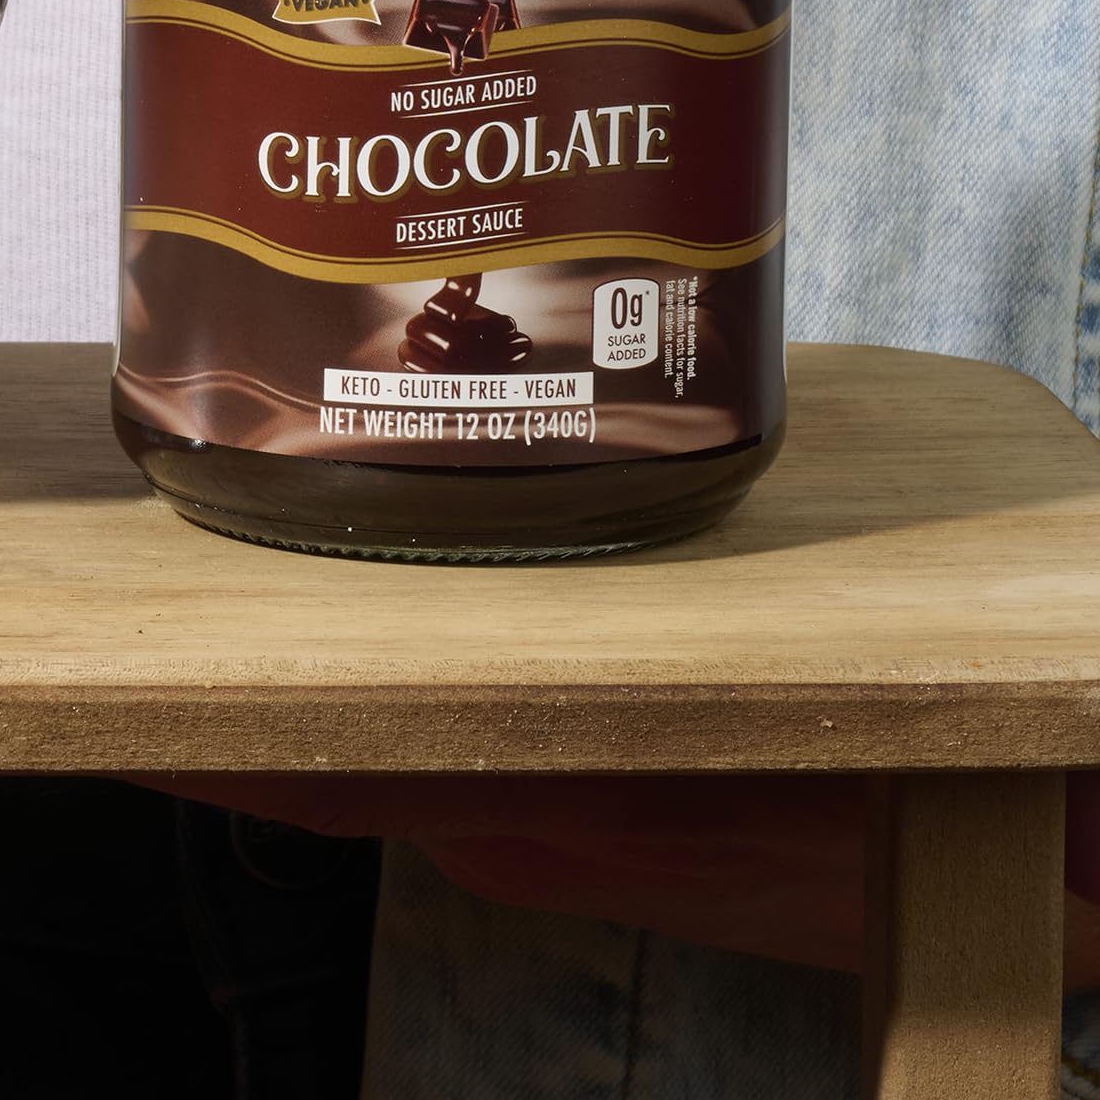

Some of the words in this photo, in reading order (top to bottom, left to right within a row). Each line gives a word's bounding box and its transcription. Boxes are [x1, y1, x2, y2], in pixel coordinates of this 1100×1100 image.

[390, 90, 414, 112] NO
[420, 83, 475, 111] SUGAR
[481, 75, 537, 103] ADDED
[258, 103, 672, 200] CHOCOLATE
[396, 216, 466, 244] DESSERT
[472, 208, 524, 233] SAUCE
[666, 280, 676, 293] fat
[677, 279, 687, 295] See
[665, 294, 675, 310] and
[677, 296, 687, 332] nutrition
[688, 306, 697, 322] low
[665, 311, 675, 342] calorie
[607, 333, 646, 347] SUGAR
[676, 333, 686, 356] facts
[687, 323, 697, 356] calorie
[607, 348, 646, 362] ADDED
[664, 343, 674, 378] content.
[676, 357, 685, 370] for
[687, 357, 697, 380] food.
[341, 376, 381, 397] KETO
[399, 379, 461, 400] GLUTEN
[469, 380, 507, 400] FREE
[525, 378, 576, 399] VEGAN
[674, 372, 684, 398] sugar,
[320, 406, 357, 435] NET
[363, 410, 447, 439] WEIGHT
[455, 413, 479, 440] 12
[487, 413, 516, 440] OZ
[523, 407, 597, 446] (340G)
